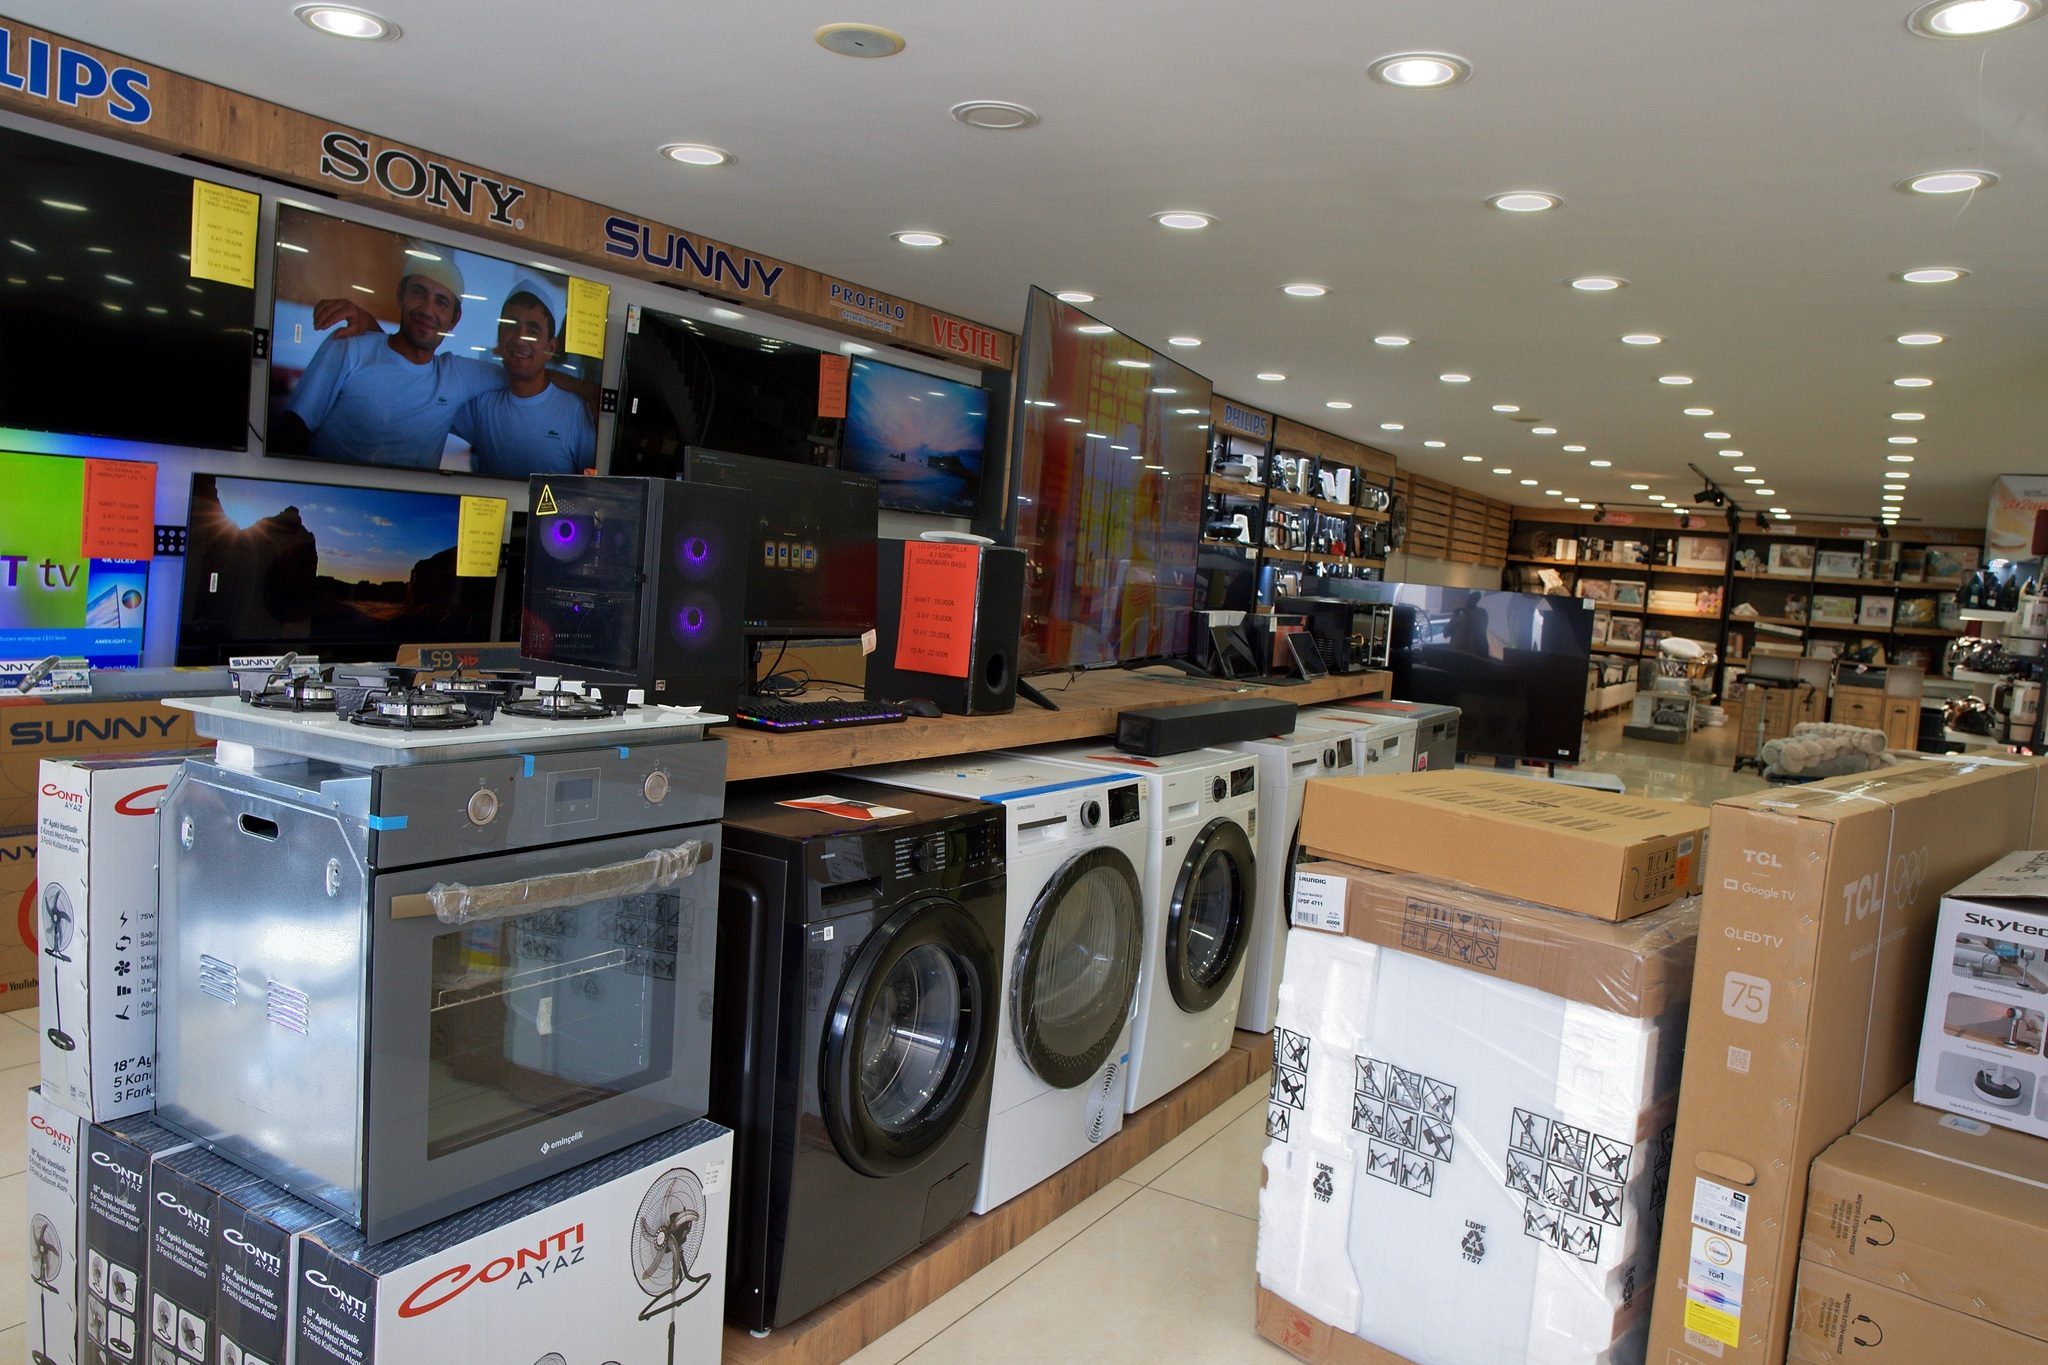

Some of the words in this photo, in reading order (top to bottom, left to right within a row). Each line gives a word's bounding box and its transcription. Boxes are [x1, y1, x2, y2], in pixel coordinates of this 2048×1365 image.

[320, 131, 525, 228] SONY
[604, 214, 784, 298] SUNNY
[931, 314, 1001, 362] VESTEL
[1224, 403, 1267, 437] PHILIPS
[39, 558, 81, 587] tv
[232, 658, 278, 667] SUNNY
[9, 714, 182, 746] SUNNY
[64, 801, 83, 813] AYAZ
[1742, 848, 1782, 868] TCL
[1741, 882, 1779, 900] Google
[1781, 889, 1796, 901] TV
[1843, 872, 1882, 926] TCL
[1724, 926, 1762, 944] QLED
[1762, 934, 1784, 949] TV
[9, 978, 39, 991] YouTub
[1729, 980, 1764, 1013] 75
[113, 1076, 122, 1088] 5
[113, 1091, 122, 1103] 3
[52, 1139, 71, 1154] AYAZ
[1316, 1161, 1334, 1175] LDPE
[120, 1178, 142, 1193] AYAZ
[1313, 1192, 1331, 1204] 1757
[187, 1219, 210, 1238] AYAZ
[1465, 1219, 1487, 1234] LDPE
[516, 1245, 585, 1291] AYAZ
[1462, 1252, 1482, 1265] 1757
[254, 1259, 280, 1278] AYAZ
[339, 1302, 366, 1324] AYAZ
[323, 1328, 340, 1345] Metal
